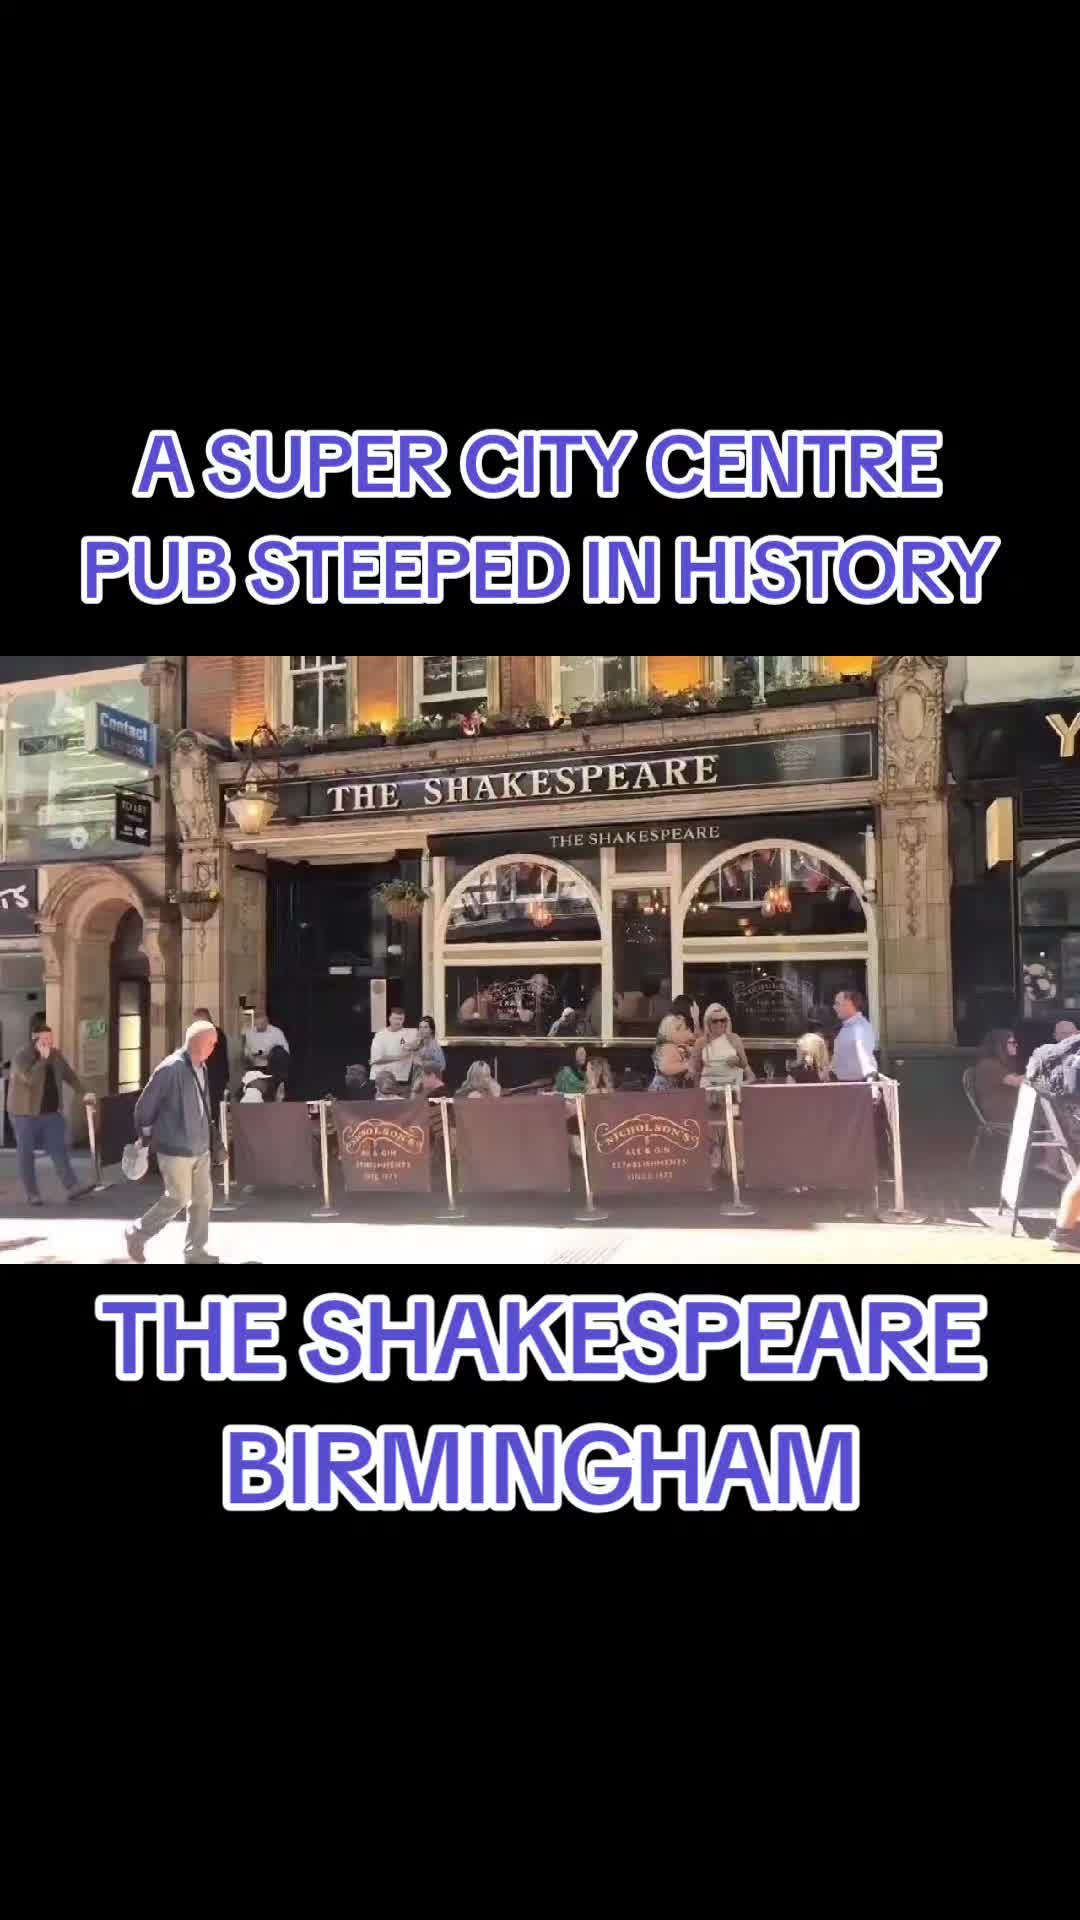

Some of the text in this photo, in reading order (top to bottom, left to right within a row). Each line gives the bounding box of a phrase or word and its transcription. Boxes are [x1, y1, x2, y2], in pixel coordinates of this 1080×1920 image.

[100, 712, 148, 741] Contact
[326, 755, 719, 813] THE SHAKESPEARE
[549, 826, 720, 848] THE SHAKESPEARE
[606, 1123, 692, 1146] NICHOLSON'S
